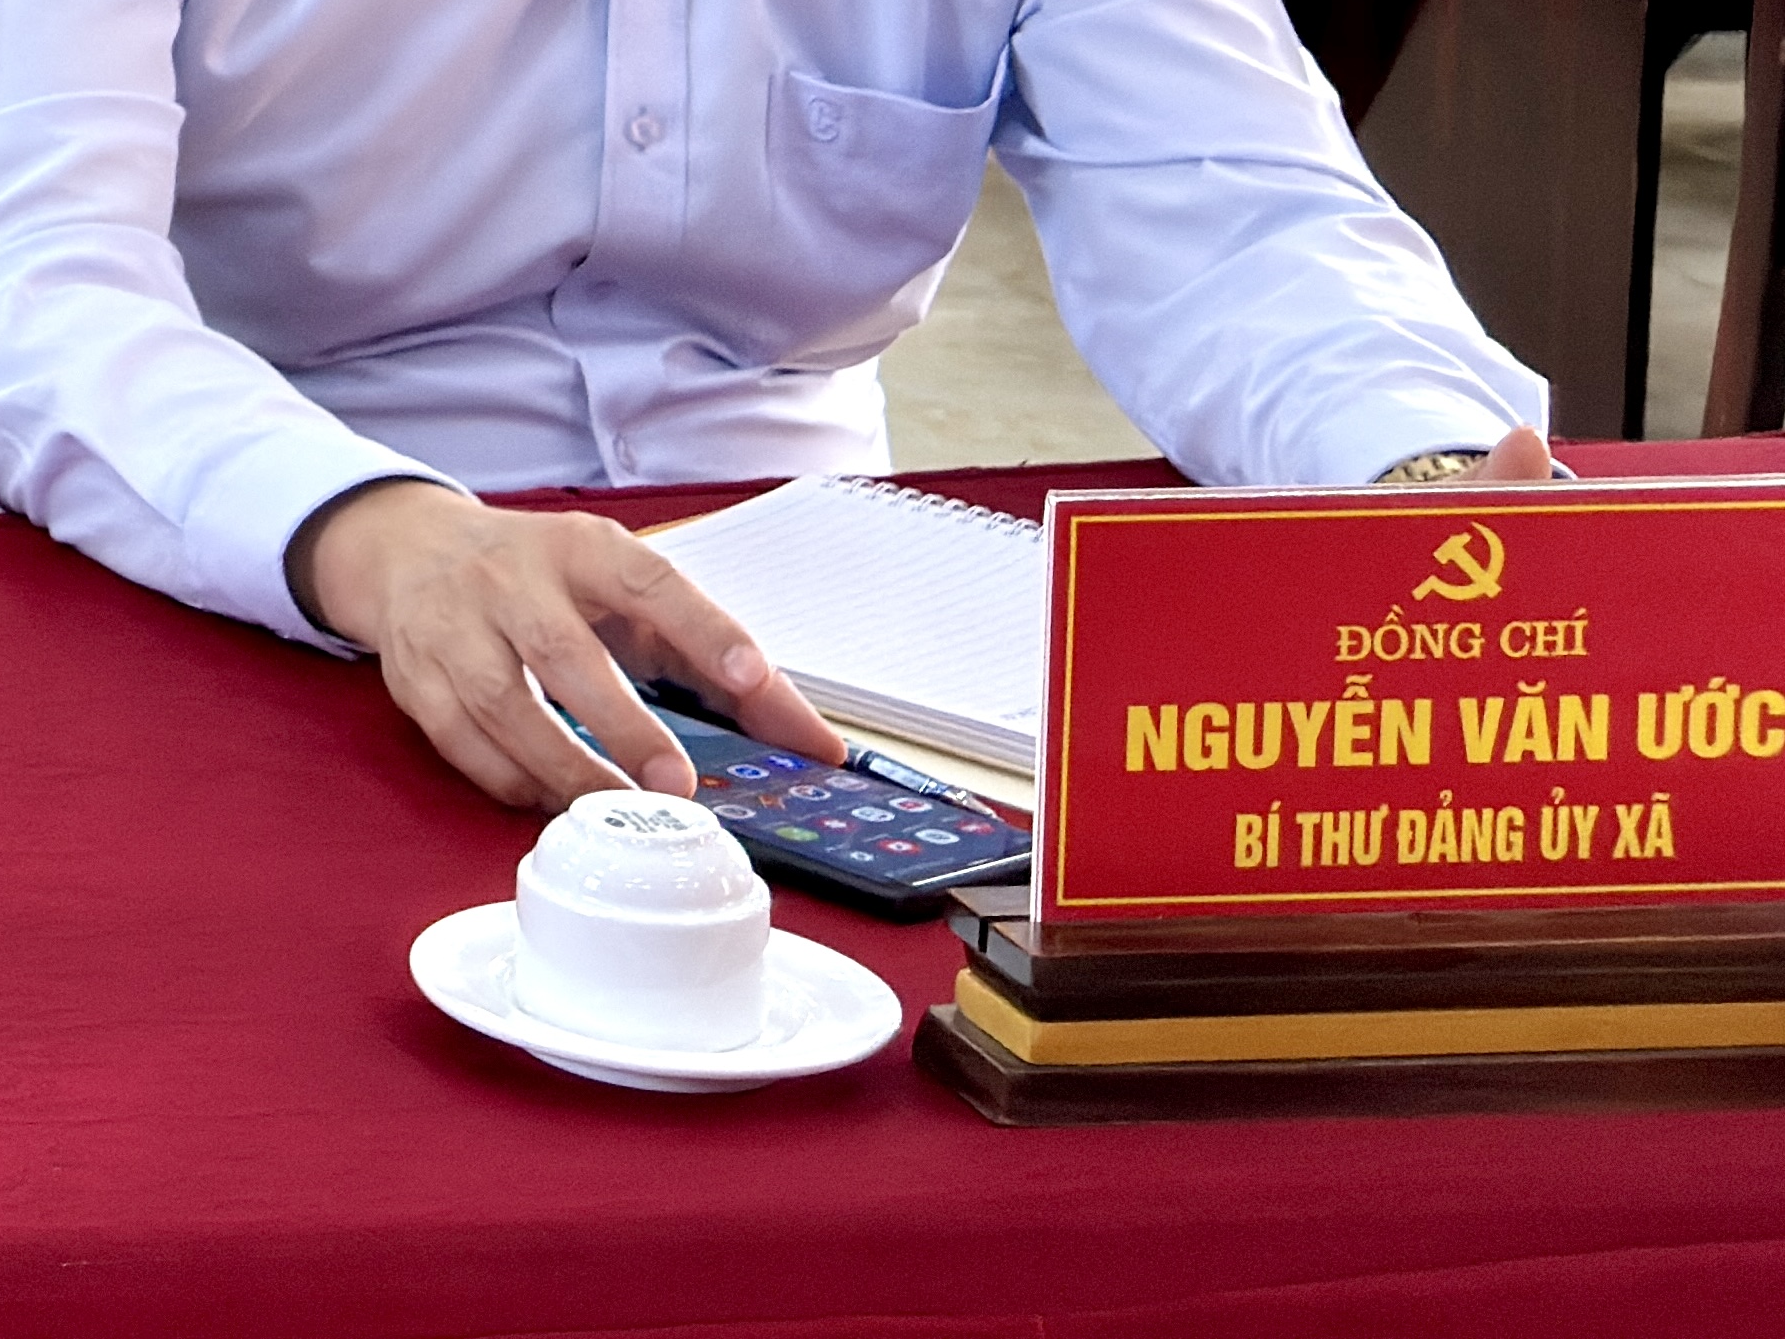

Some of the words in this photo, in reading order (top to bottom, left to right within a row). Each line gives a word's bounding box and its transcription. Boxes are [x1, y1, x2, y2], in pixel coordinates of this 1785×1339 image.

[1337, 606, 1485, 660] ĐỒNG
[1500, 609, 1588, 657] CHÍ
[1126, 675, 1431, 771] NGUYỄN
[1459, 682, 1609, 763] VĂN
[1637, 677, 1785, 759] ƯỚC
[1235, 802, 1280, 867] BÍ
[1296, 805, 1389, 866] THƯ
[1397, 791, 1524, 863] ĐẢNG
[1540, 787, 1599, 860] ỦY
[1613, 793, 1674, 858] XÃ
